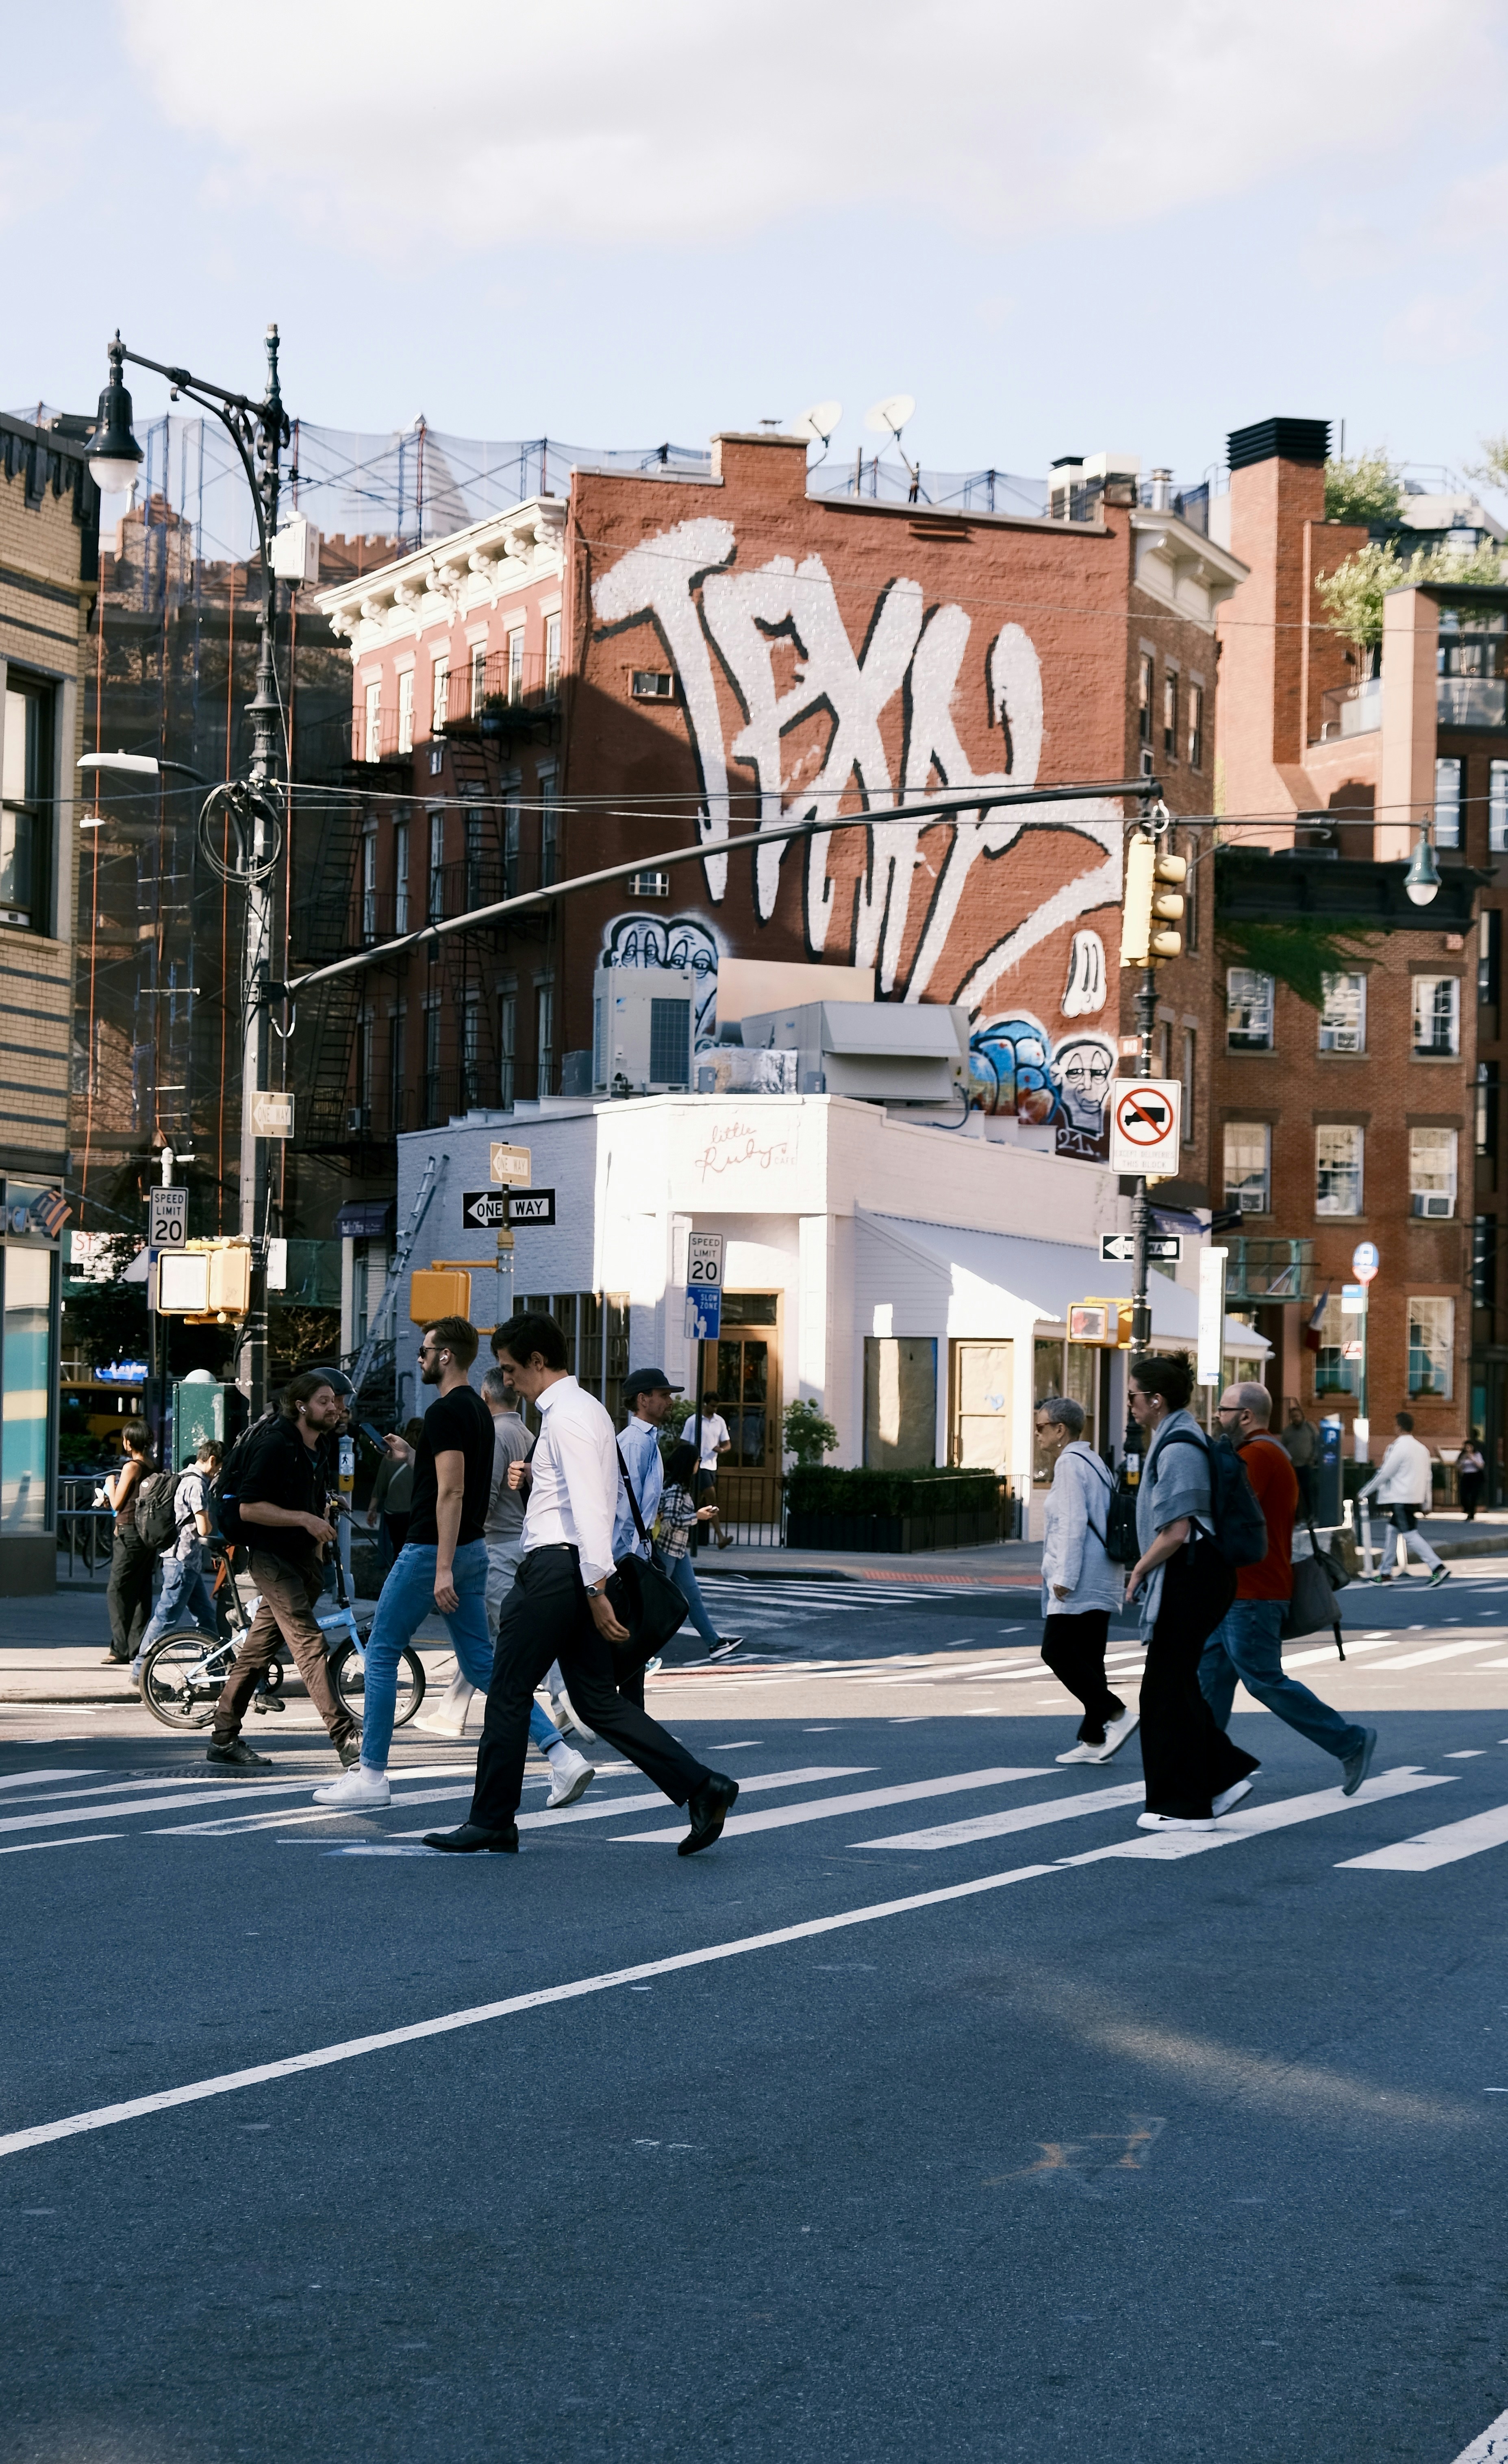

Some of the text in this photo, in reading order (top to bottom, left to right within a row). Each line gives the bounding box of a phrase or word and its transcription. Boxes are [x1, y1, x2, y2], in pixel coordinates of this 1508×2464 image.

[258, 1107, 289, 1122] ONE WAY
[711, 1122, 757, 1144] little
[1115, 1149, 1137, 1158] EXCEPT
[497, 1156, 526, 1173] ONE WAY
[154, 1193, 183, 1204] SPEED
[156, 1206, 181, 1216] LIMIT
[477, 1200, 543, 1217] ONE WAY
[155, 1220, 182, 1241] 20
[692, 1238, 720, 1246] SPEED
[1115, 1243, 1170, 1252] ONE WAY
[692, 1261, 717, 1280] 20
[1327, 1430, 1336, 1443] P
